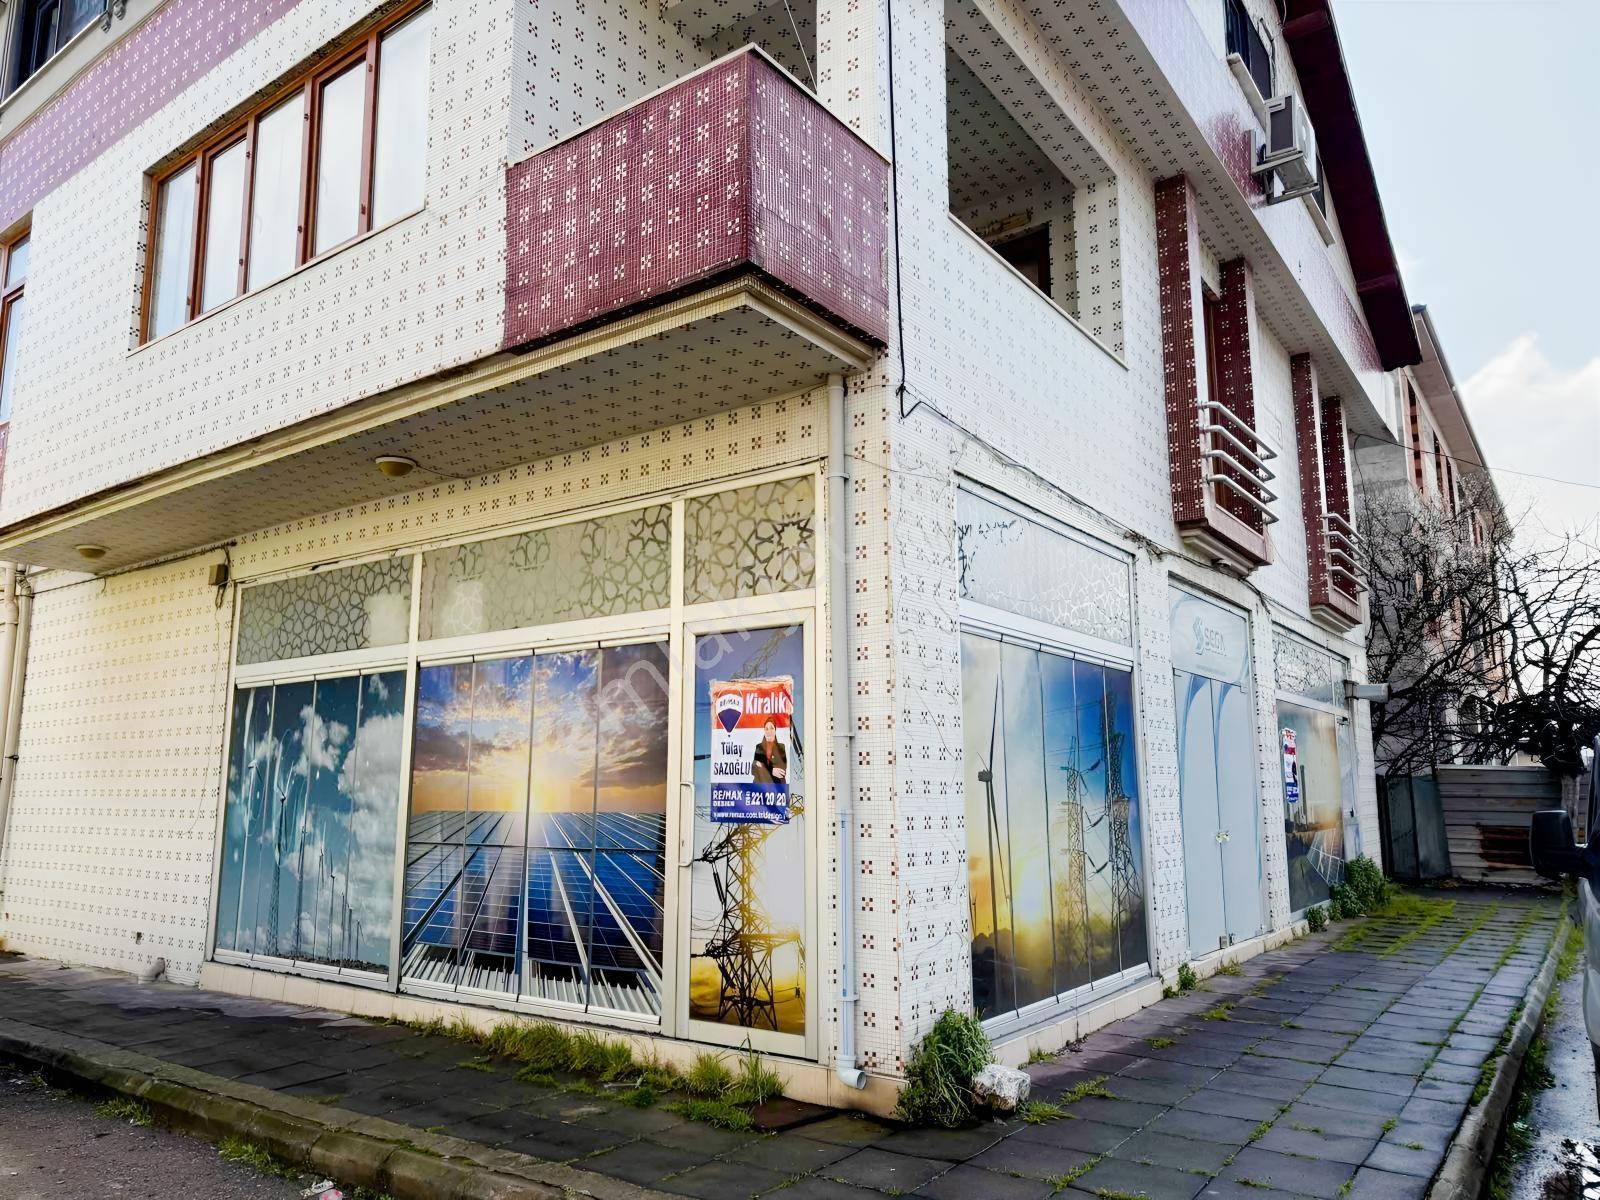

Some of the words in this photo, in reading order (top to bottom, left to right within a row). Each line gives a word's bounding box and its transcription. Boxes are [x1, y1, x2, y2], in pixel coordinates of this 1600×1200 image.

[746, 691, 787, 714] Kiralık
[720, 742, 744, 758] Tülay
[714, 759, 751, 776] SAZOĞLU
[712, 790, 743, 801] RE/MAX
